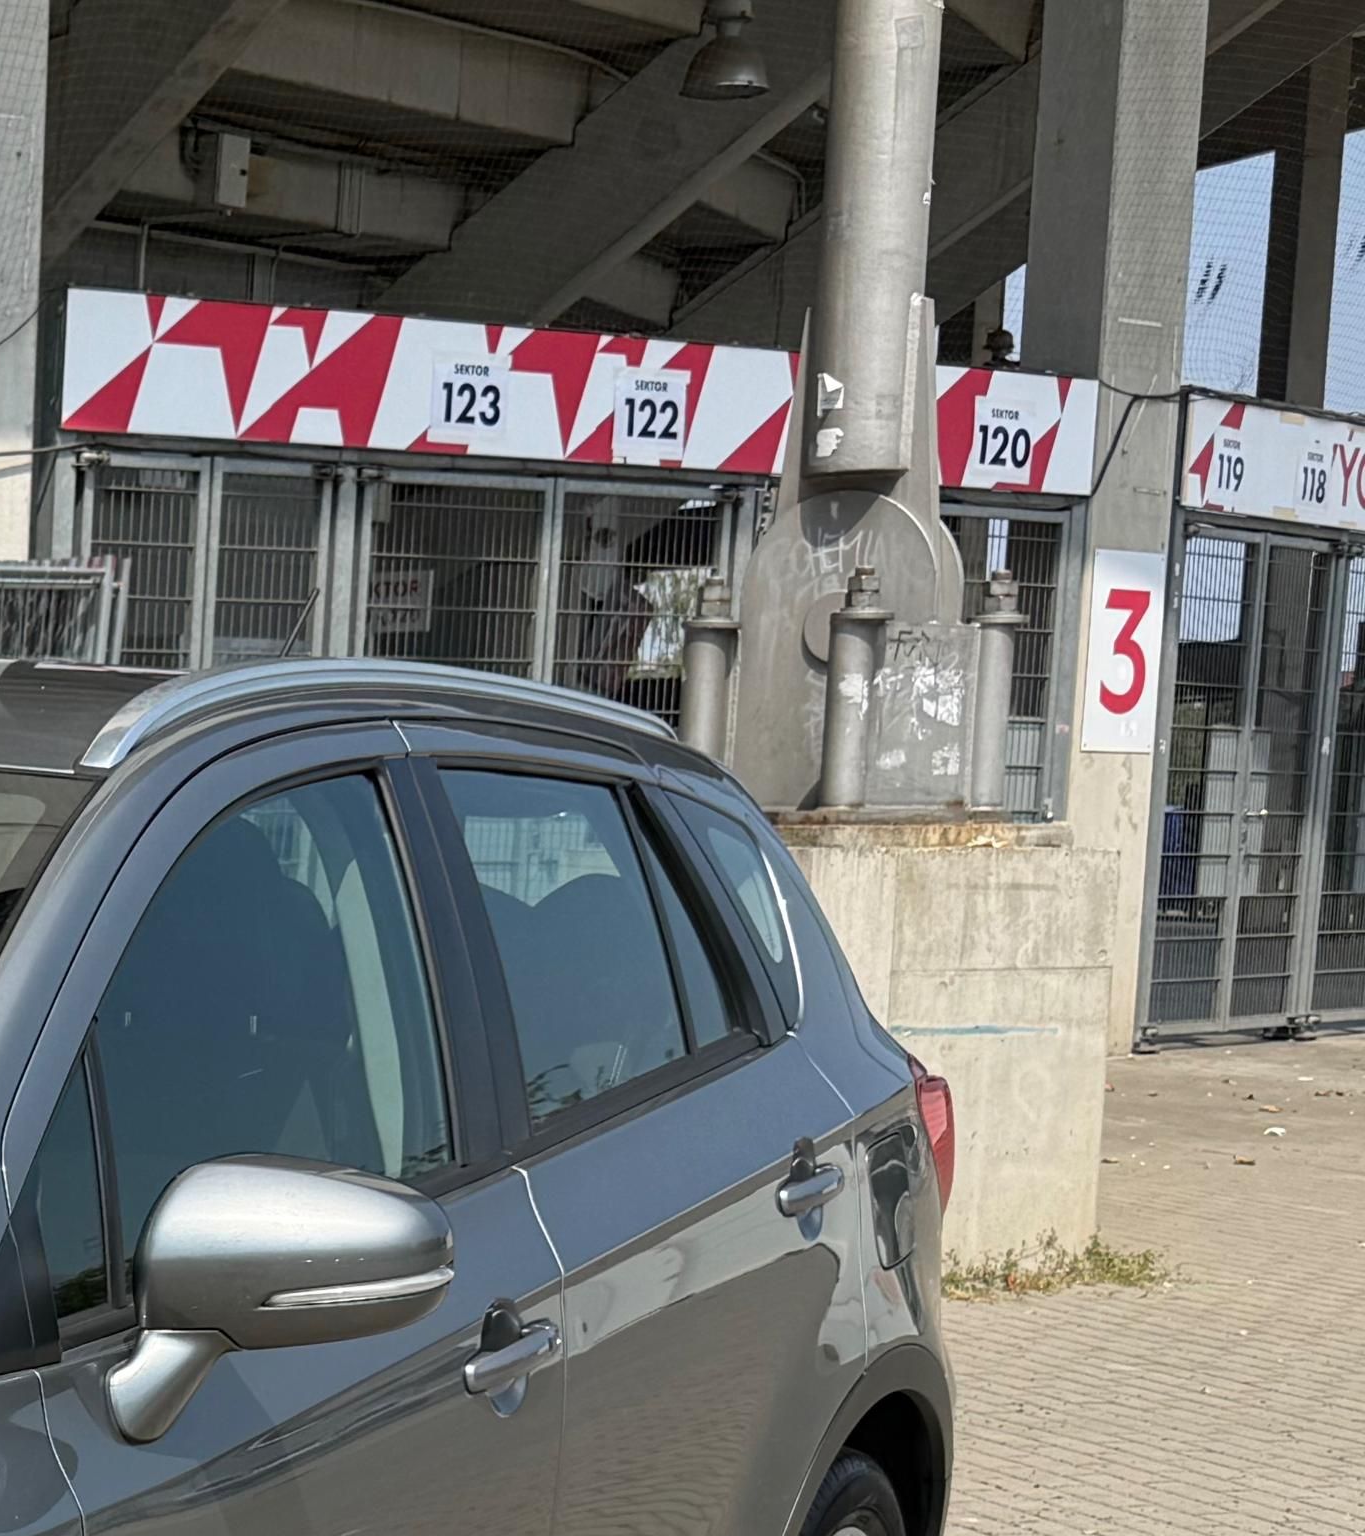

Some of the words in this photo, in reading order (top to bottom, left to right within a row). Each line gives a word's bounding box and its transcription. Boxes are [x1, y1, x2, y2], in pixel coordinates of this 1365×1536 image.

[454, 363, 490, 377] SEKTOR
[634, 379, 668, 392] SEKTOR
[442, 382, 501, 427] 123
[624, 398, 679, 440] 122
[991, 408, 1020, 420] SEKTOR
[978, 424, 1031, 469] 120
[1218, 453, 1244, 492] 119
[1302, 466, 1327, 504] 118
[1099, 588, 1151, 715] 3
